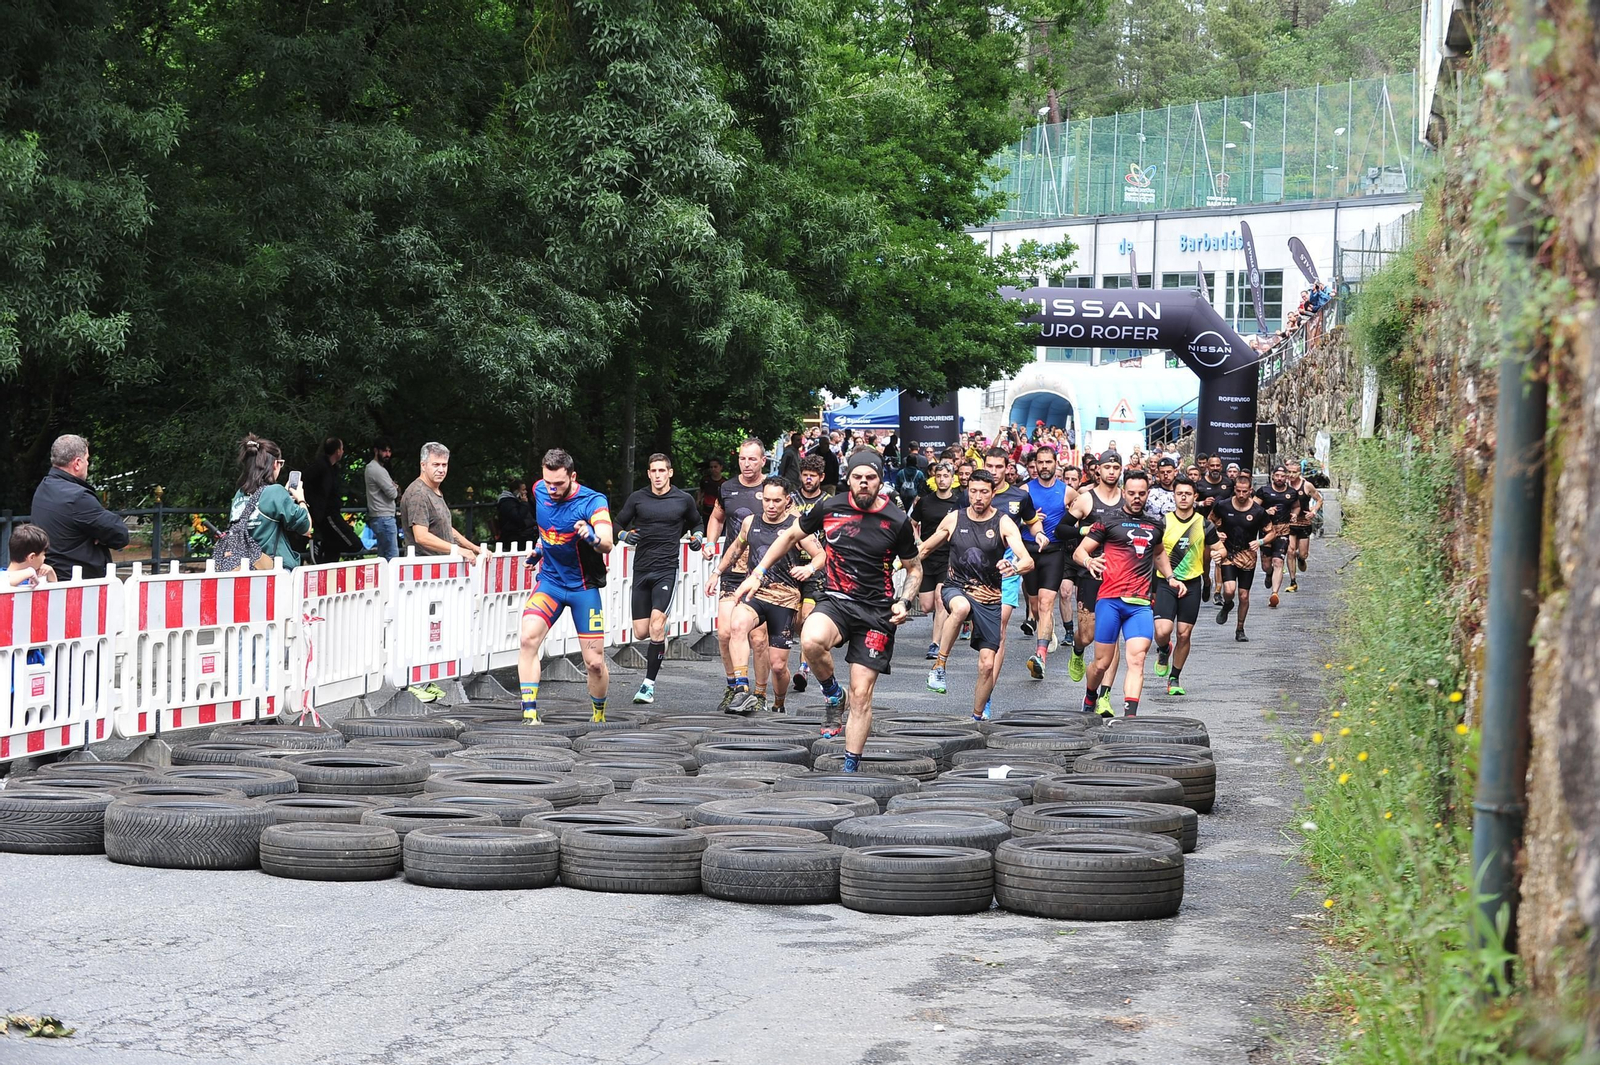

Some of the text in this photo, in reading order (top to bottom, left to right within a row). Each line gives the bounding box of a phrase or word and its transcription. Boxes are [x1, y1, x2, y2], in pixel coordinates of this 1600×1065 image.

[1119, 230, 1244, 255] de Barbadás
[1015, 322, 1160, 341] UPO ROFER
[1188, 344, 1232, 354] NISSAN
[1218, 395, 1251, 403] ROFERVIGO
[1210, 421, 1252, 429] ROFEROURENSE
